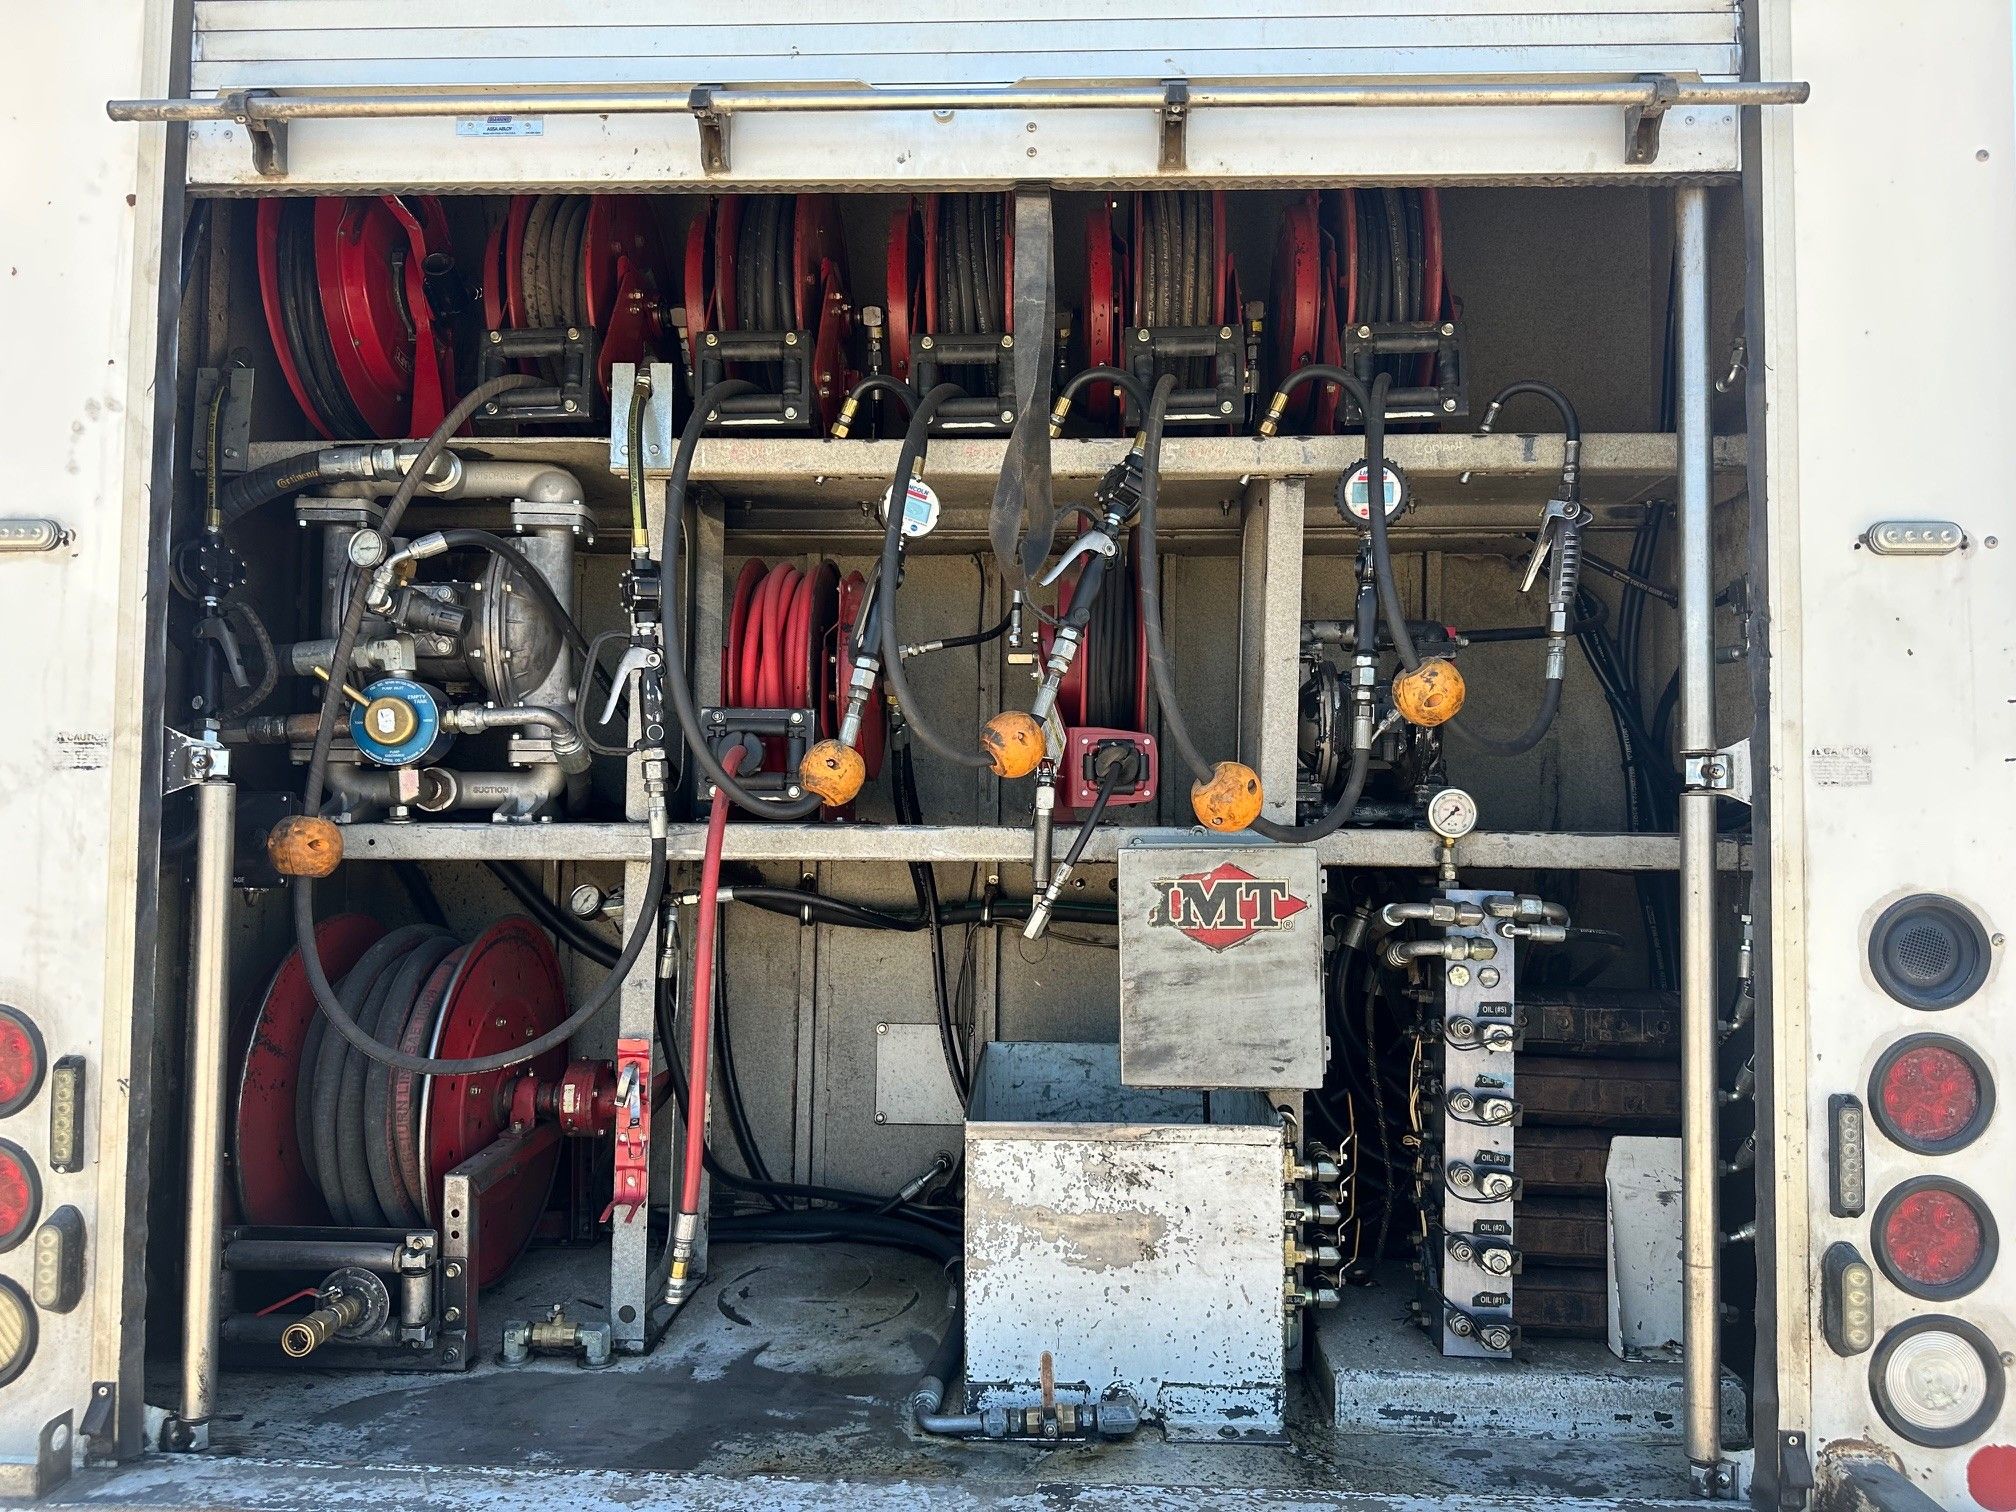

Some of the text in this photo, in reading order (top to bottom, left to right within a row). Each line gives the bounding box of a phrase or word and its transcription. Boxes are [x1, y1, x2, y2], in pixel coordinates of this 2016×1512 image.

[1824, 747, 1868, 756] CATION
[1148, 880, 1290, 929] IMT
[1482, 1154, 1492, 1162] OIL
[1492, 1224, 1504, 1232] (#2)
[1480, 1296, 1504, 1305] OIL (#1)
